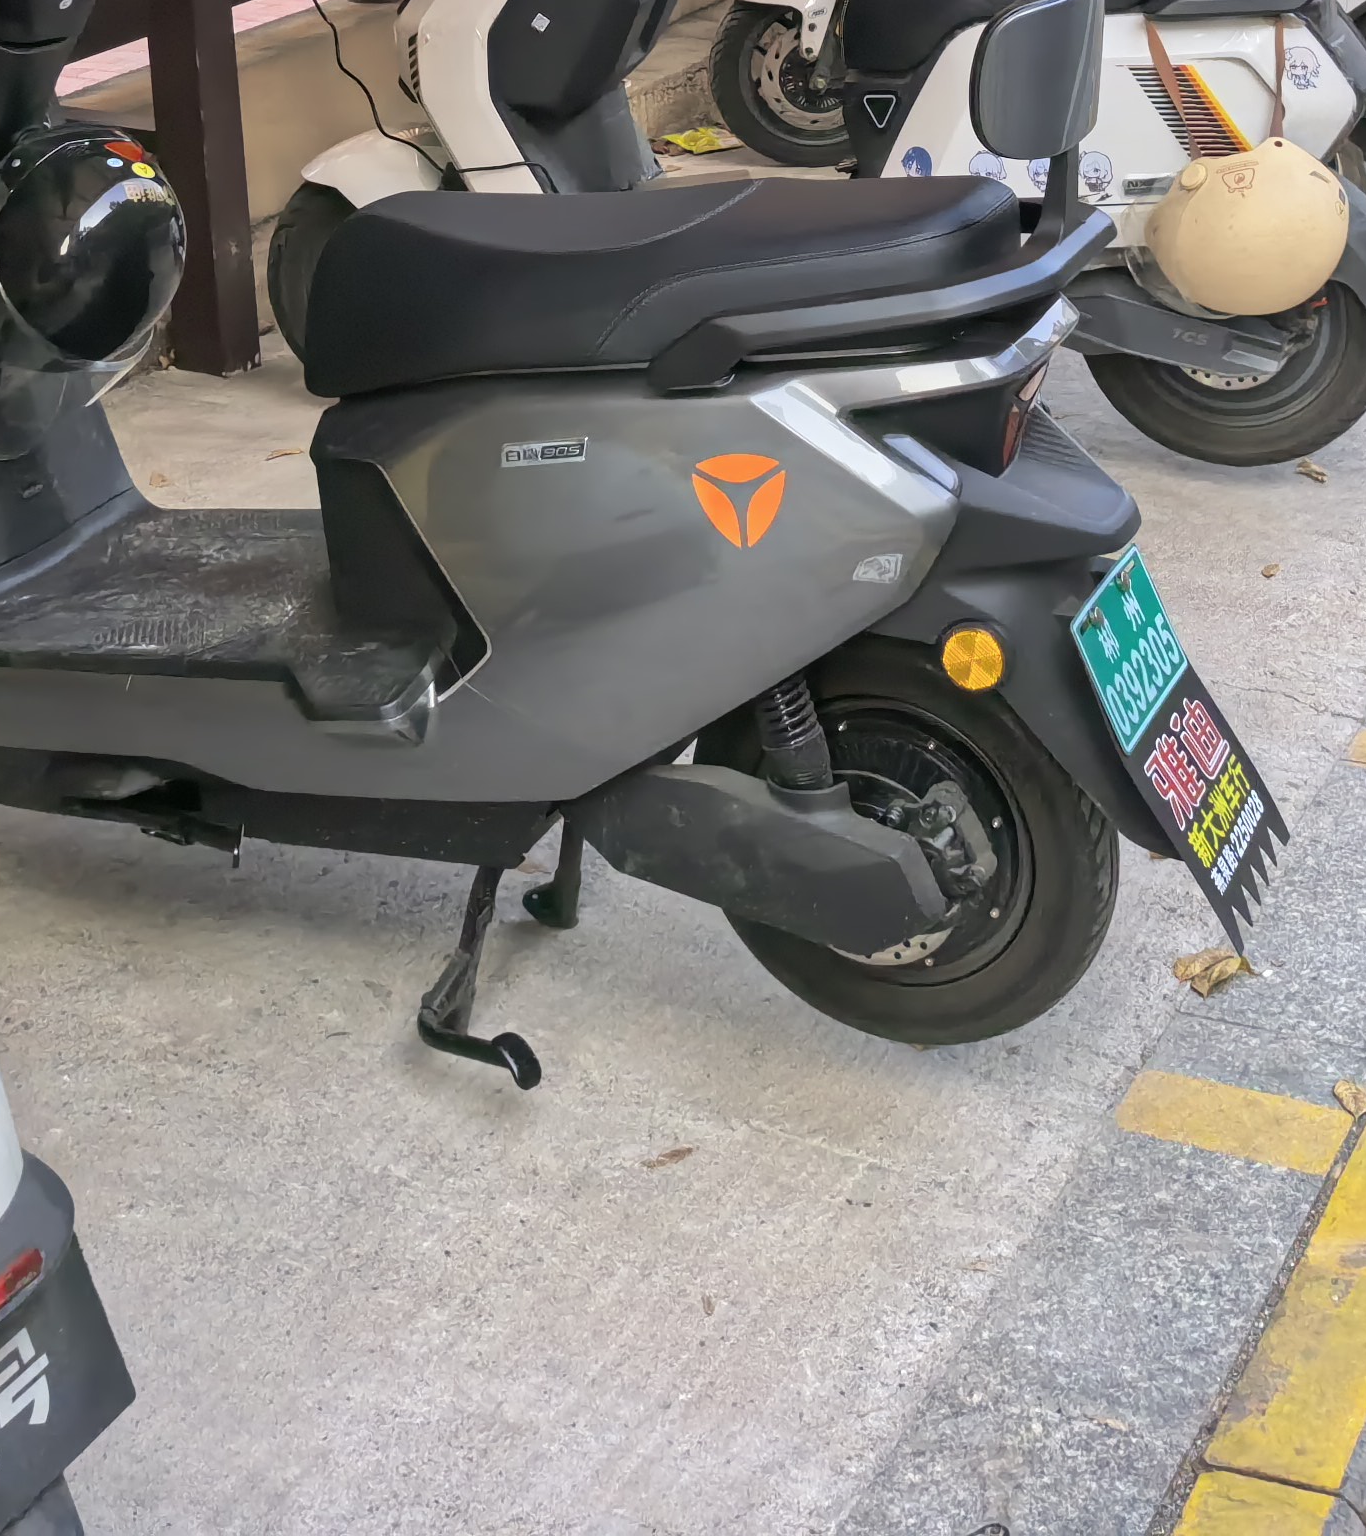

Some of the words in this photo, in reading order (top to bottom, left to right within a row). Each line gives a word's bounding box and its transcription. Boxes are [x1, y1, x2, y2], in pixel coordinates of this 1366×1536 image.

[1106, 612, 1181, 736] 0392305
[1143, 697, 1230, 832] 雅迪
[1187, 753, 1251, 869] 新大洲车行
